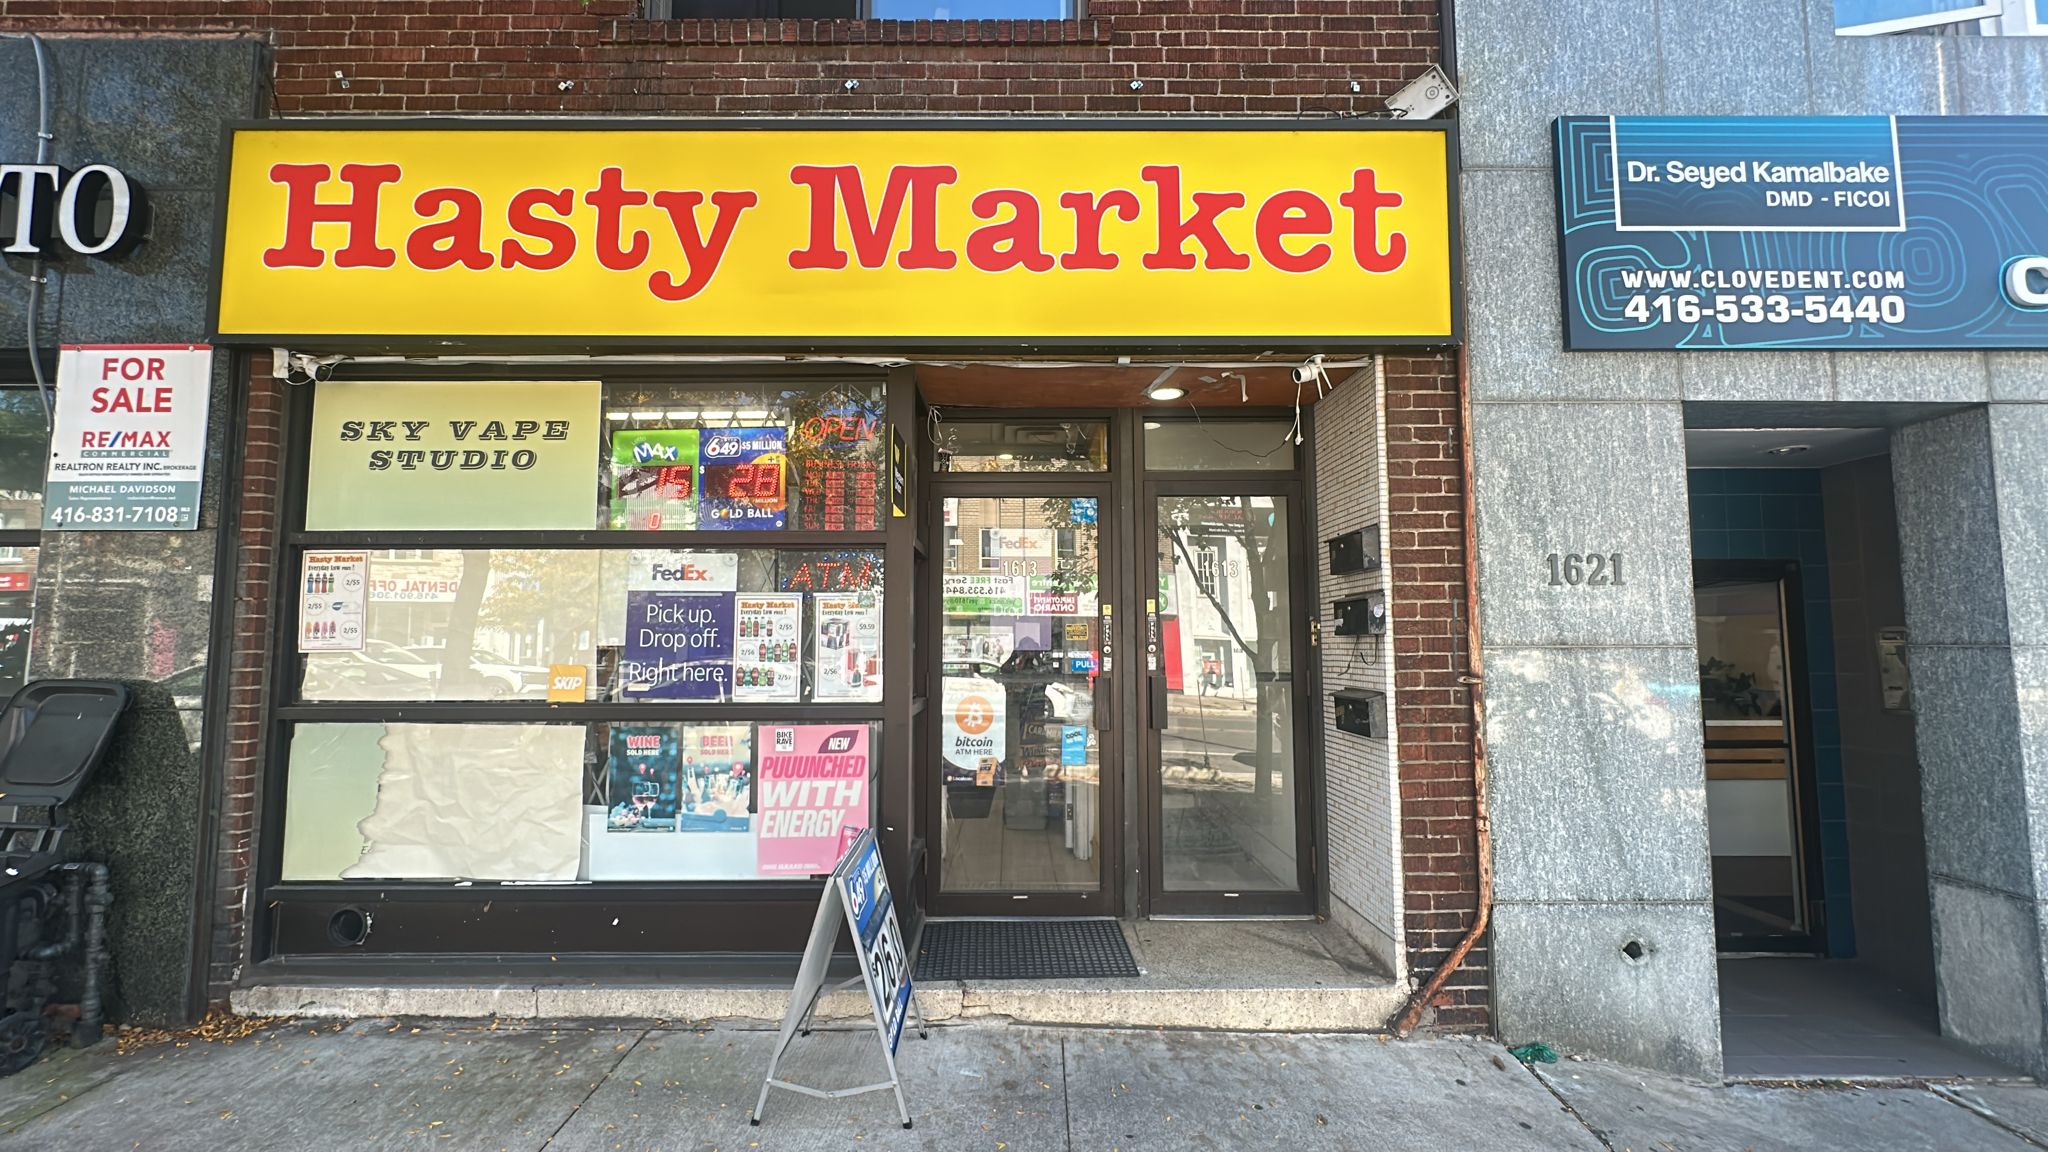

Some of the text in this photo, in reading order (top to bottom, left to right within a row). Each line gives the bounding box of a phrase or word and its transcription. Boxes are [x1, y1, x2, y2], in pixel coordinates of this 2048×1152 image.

[1627, 161, 1890, 188] Dr. Seyed Kamalbake
[1766, 191, 1813, 207] DMD
[1834, 190, 1891, 207] FICOI
[0, 163, 131, 255] TO
[264, 164, 1406, 300] Hasty Market
[1621, 270, 1905, 289] WWW.CLOVEDENT.COM
[1624, 294, 1905, 324] 416-533-5440
[102, 357, 165, 381] FOR
[91, 387, 173, 413] SALE
[340, 419, 571, 442] SKY VAPE
[804, 416, 877, 441] OPEN
[82, 431, 171, 448] RE/MAX
[752, 441, 783, 450] MILLION
[368, 448, 538, 471] STUDIO
[633, 442, 677, 463] MAX
[55, 463, 104, 471] REALTRON
[106, 463, 141, 471] REALTY
[143, 462, 162, 471] INC.
[69, 485, 176, 494] MICHAEL DAVIDSON
[728, 464, 780, 498] 28
[51, 506, 178, 524] 416-831-7108
[747, 508, 773, 518] BALL
[309, 555, 363, 564] Hasty Market
[1003, 560, 1038, 577] 1613
[1203, 560, 1239, 577] 1613
[1546, 552, 1625, 586] 1621
[652, 563, 708, 581] FedEx
[789, 562, 872, 589] ATM
[766, 601, 795, 609] Market
[646, 604, 716, 628] Pick up.
[640, 628, 721, 652] Drop off.
[629, 657, 728, 687] Right here.
[1075, 660, 1096, 668] PULL
[552, 675, 583, 691] SKIP
[627, 735, 661, 749] WINE
[700, 735, 733, 748] BEER
[828, 737, 851, 750] NEW
[955, 736, 993, 748] bitcoin
[973, 748, 993, 756] HERE
[760, 755, 866, 779] PUUUNCHED
[761, 780, 863, 808] WITH
[760, 810, 845, 838] ENERGY
